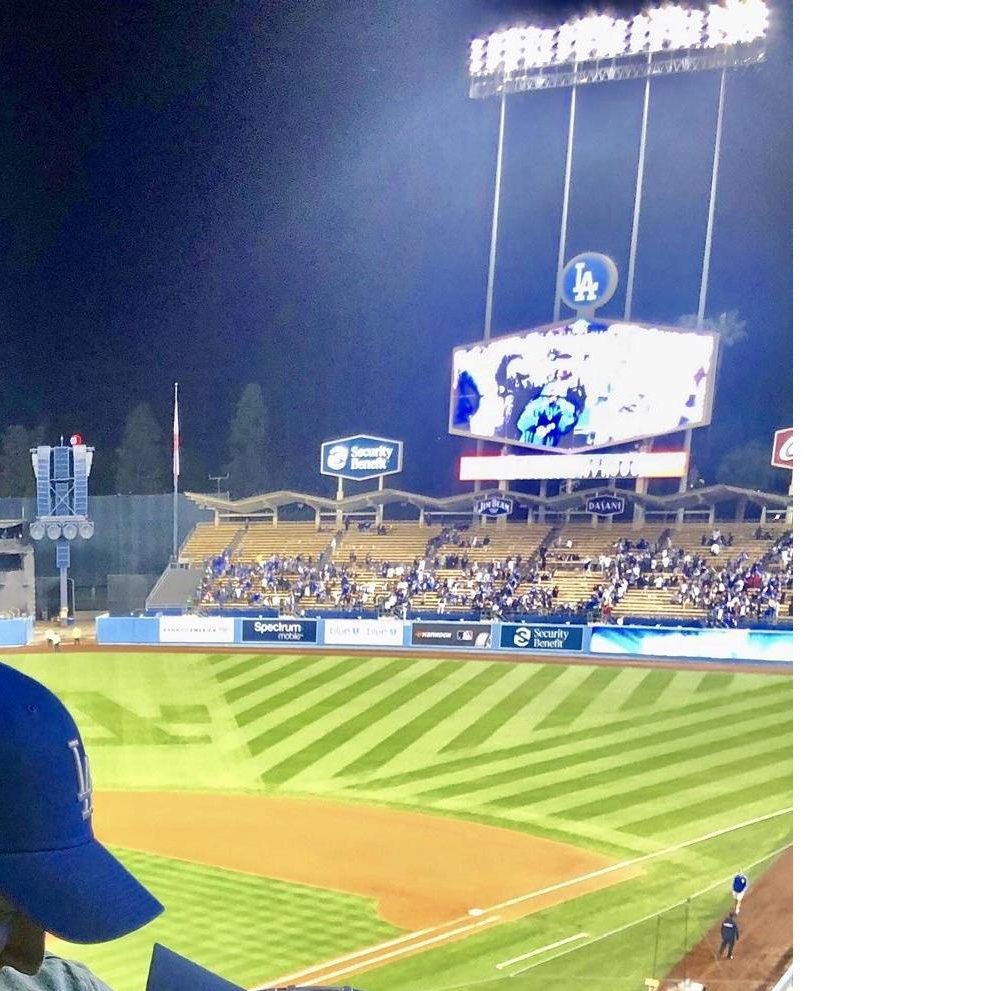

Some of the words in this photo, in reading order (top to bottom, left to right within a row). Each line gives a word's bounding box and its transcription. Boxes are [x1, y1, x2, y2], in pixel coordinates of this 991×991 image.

[573, 262, 599, 301] LA
[351, 445, 393, 459] Security
[350, 457, 387, 470] Benefit
[589, 502, 621, 511] DASANI
[254, 622, 302, 634] Spectrum
[533, 628, 569, 640] Security
[533, 638, 563, 648] Benefit
